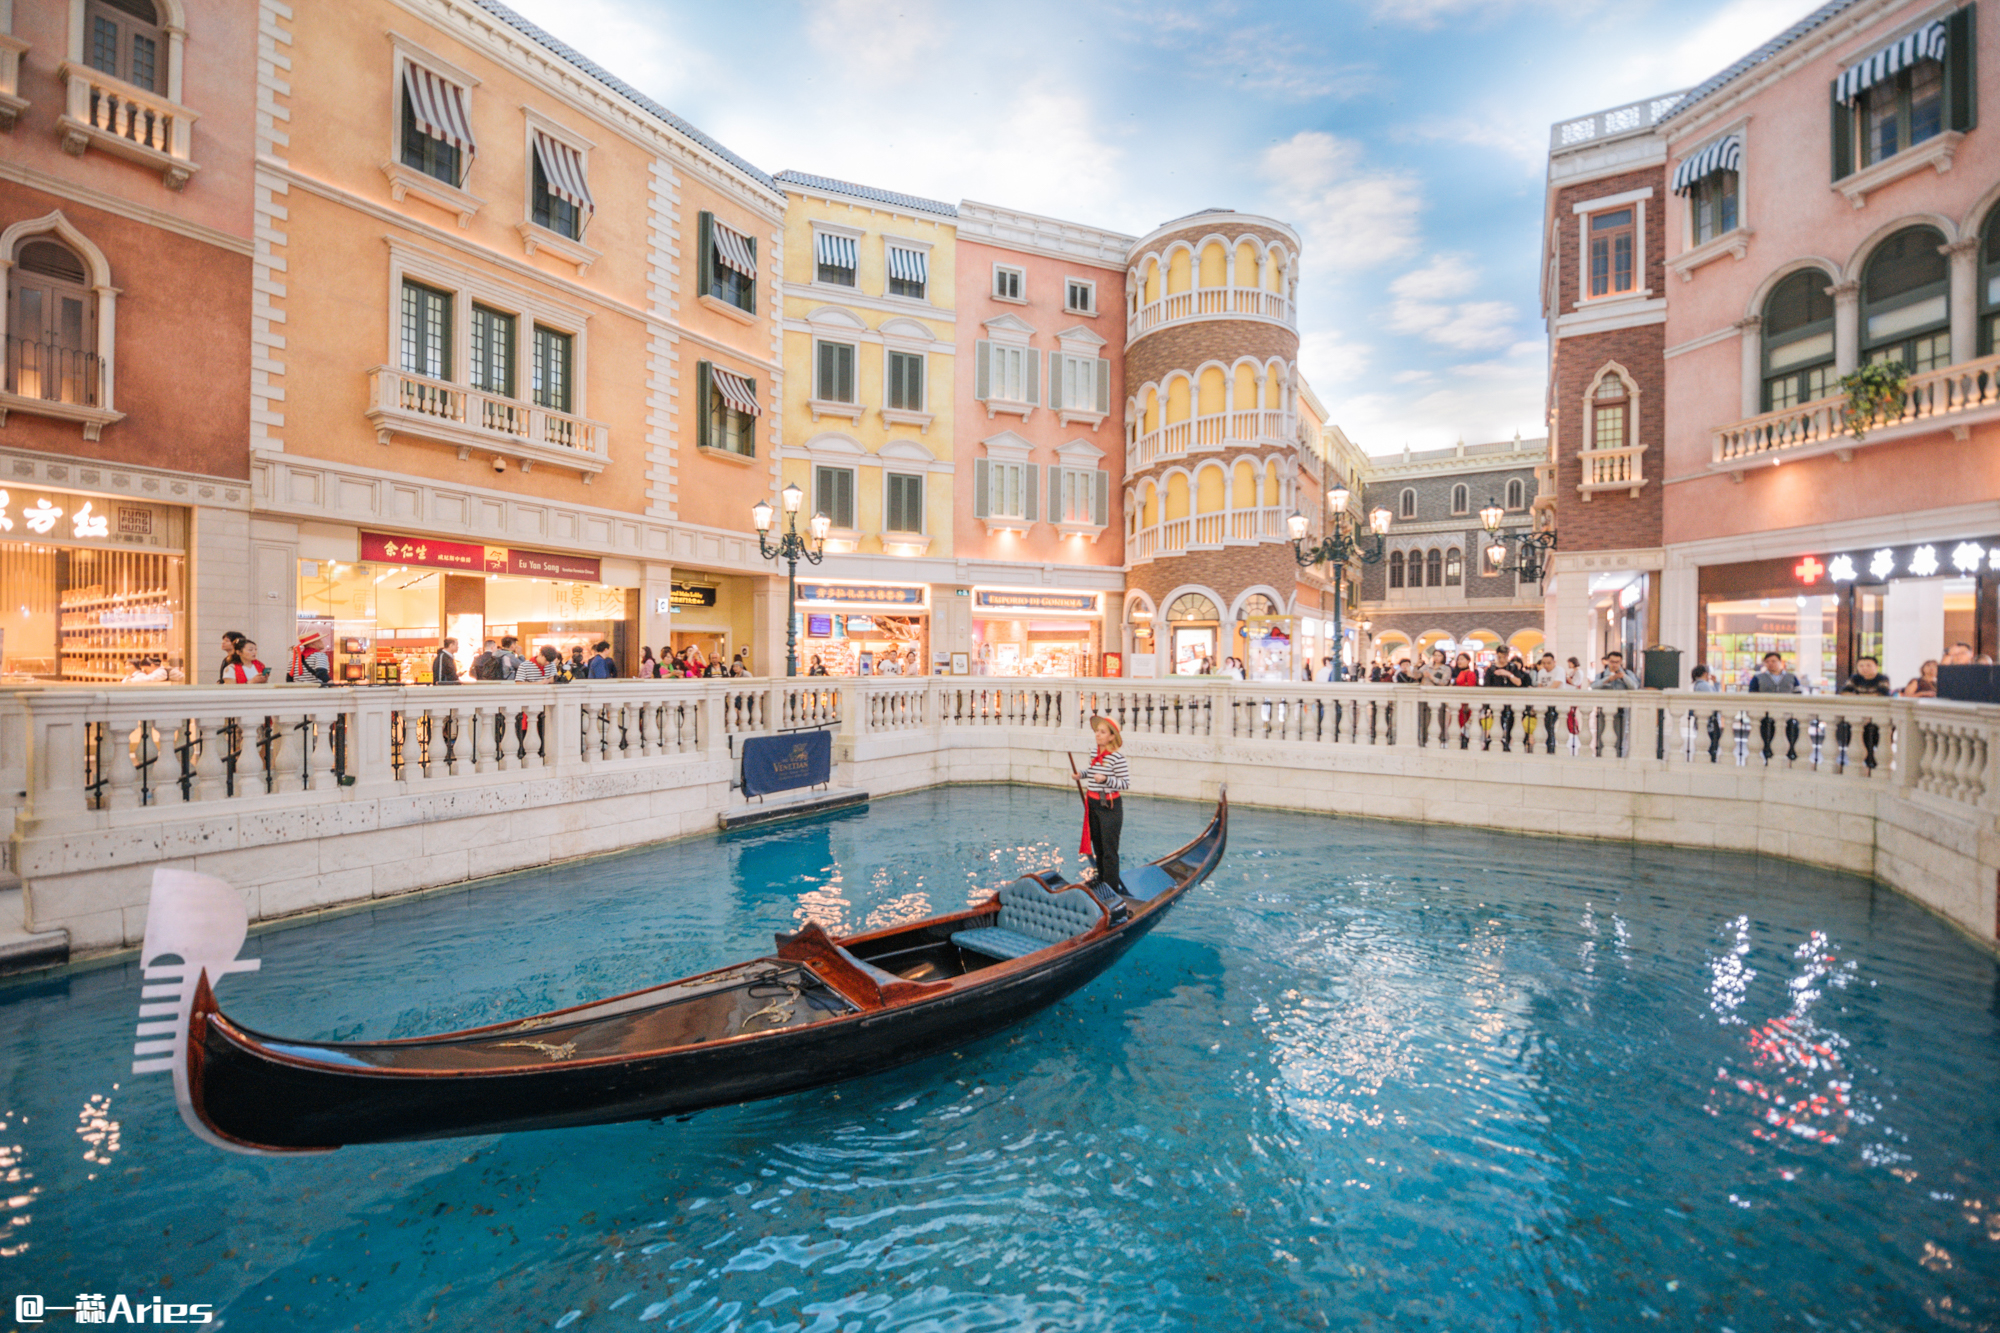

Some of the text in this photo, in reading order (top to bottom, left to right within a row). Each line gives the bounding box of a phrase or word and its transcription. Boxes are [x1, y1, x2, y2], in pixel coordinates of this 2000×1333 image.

[122, 509, 148, 518] TUNG
[121, 516, 148, 525] FONG
[121, 524, 148, 533] HUNG
[384, 540, 428, 560] 余仁生
[518, 560, 560, 573] Eu Yan Sang
[988, 595, 1083, 607] EMPORIO DI GONDOLA
[773, 761, 809, 773] VENETIAN
